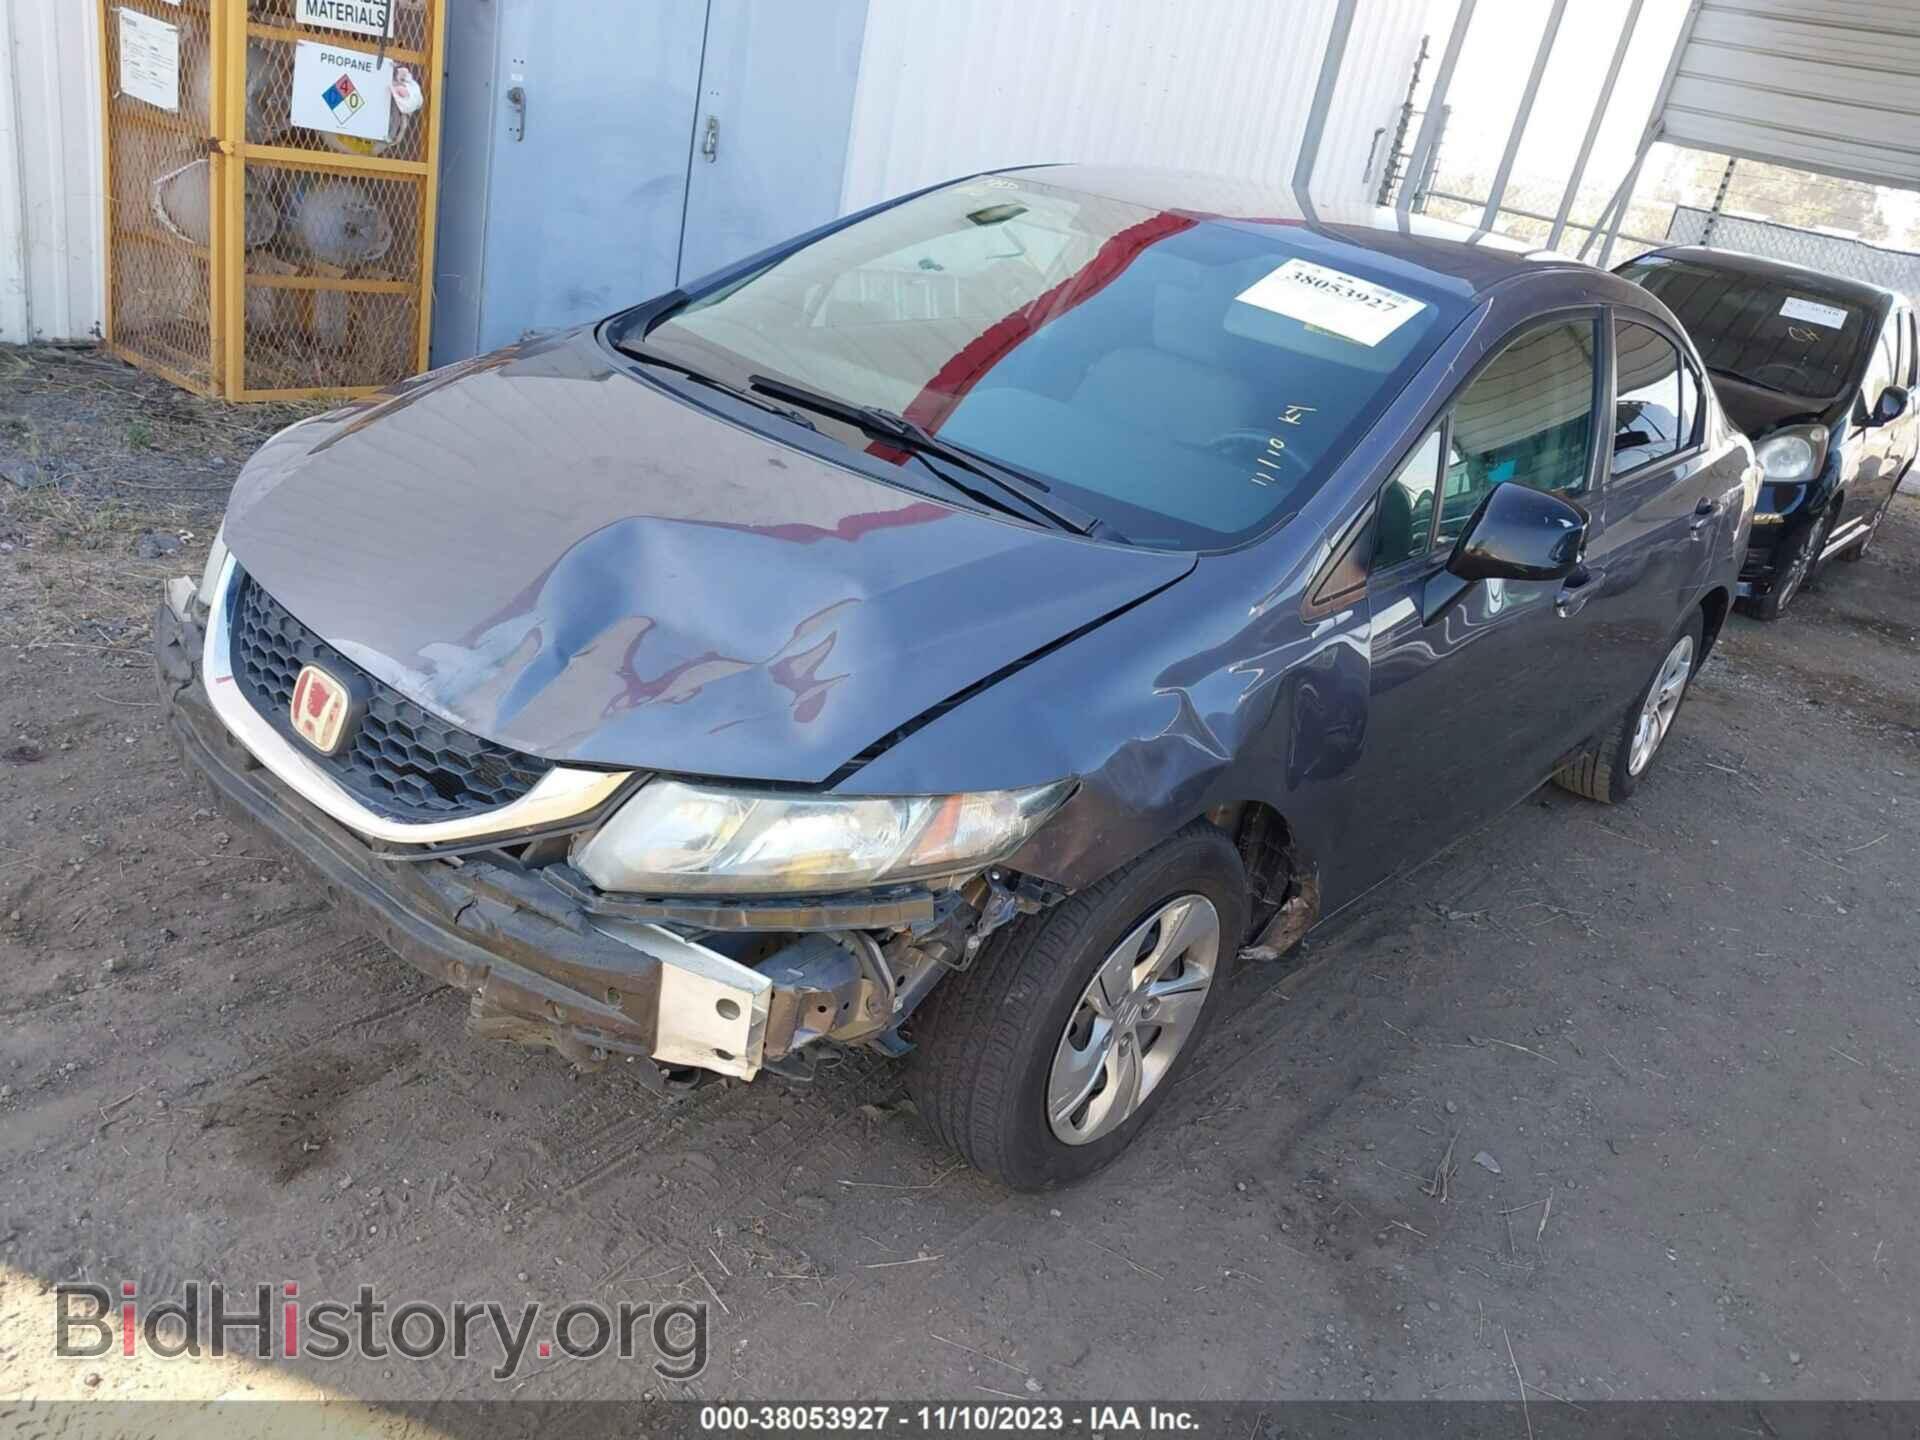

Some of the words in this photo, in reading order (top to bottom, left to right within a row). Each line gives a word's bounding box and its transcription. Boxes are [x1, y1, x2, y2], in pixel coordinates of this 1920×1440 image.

[306, 0, 386, 28] MATERIALS
[320, 52, 373, 73] PROPANE
[340, 80, 348, 93] 4
[349, 92, 359, 109] 0
